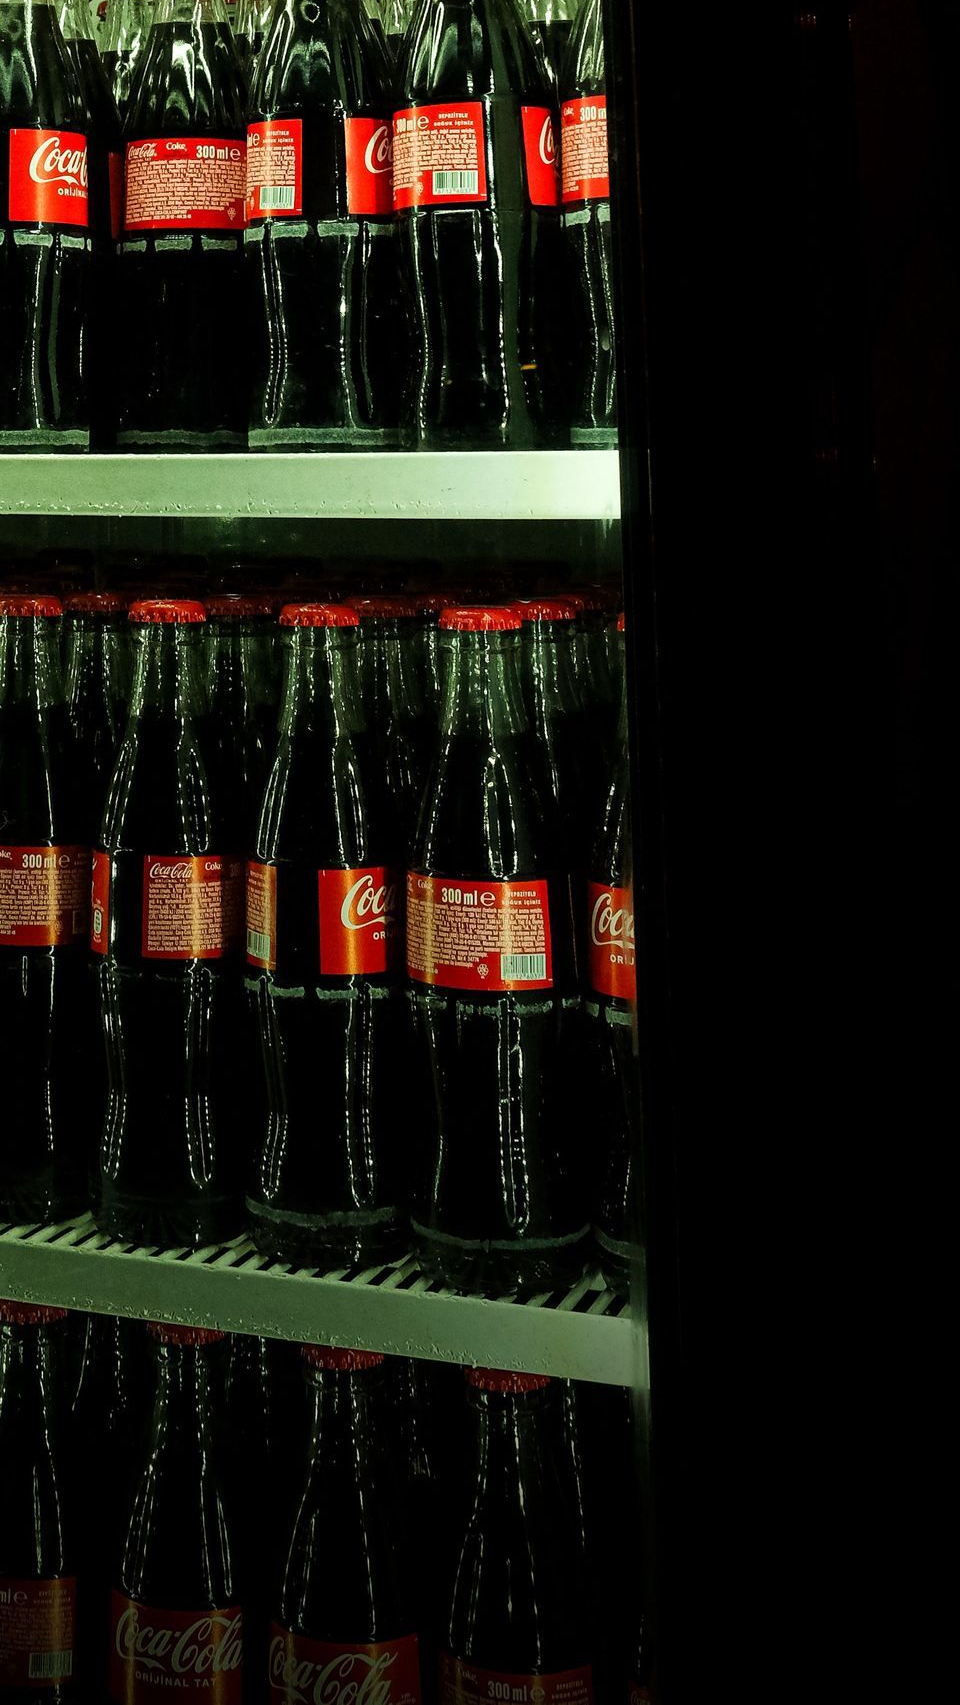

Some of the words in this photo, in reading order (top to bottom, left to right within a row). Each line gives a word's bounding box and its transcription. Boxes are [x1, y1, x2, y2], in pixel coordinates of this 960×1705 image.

[580, 106, 596, 122] 300
[166, 142, 187, 152] Coke
[22, 853, 42, 869] 300
[441, 887, 462, 905] 300
[487, 1679, 512, 1700] 300
